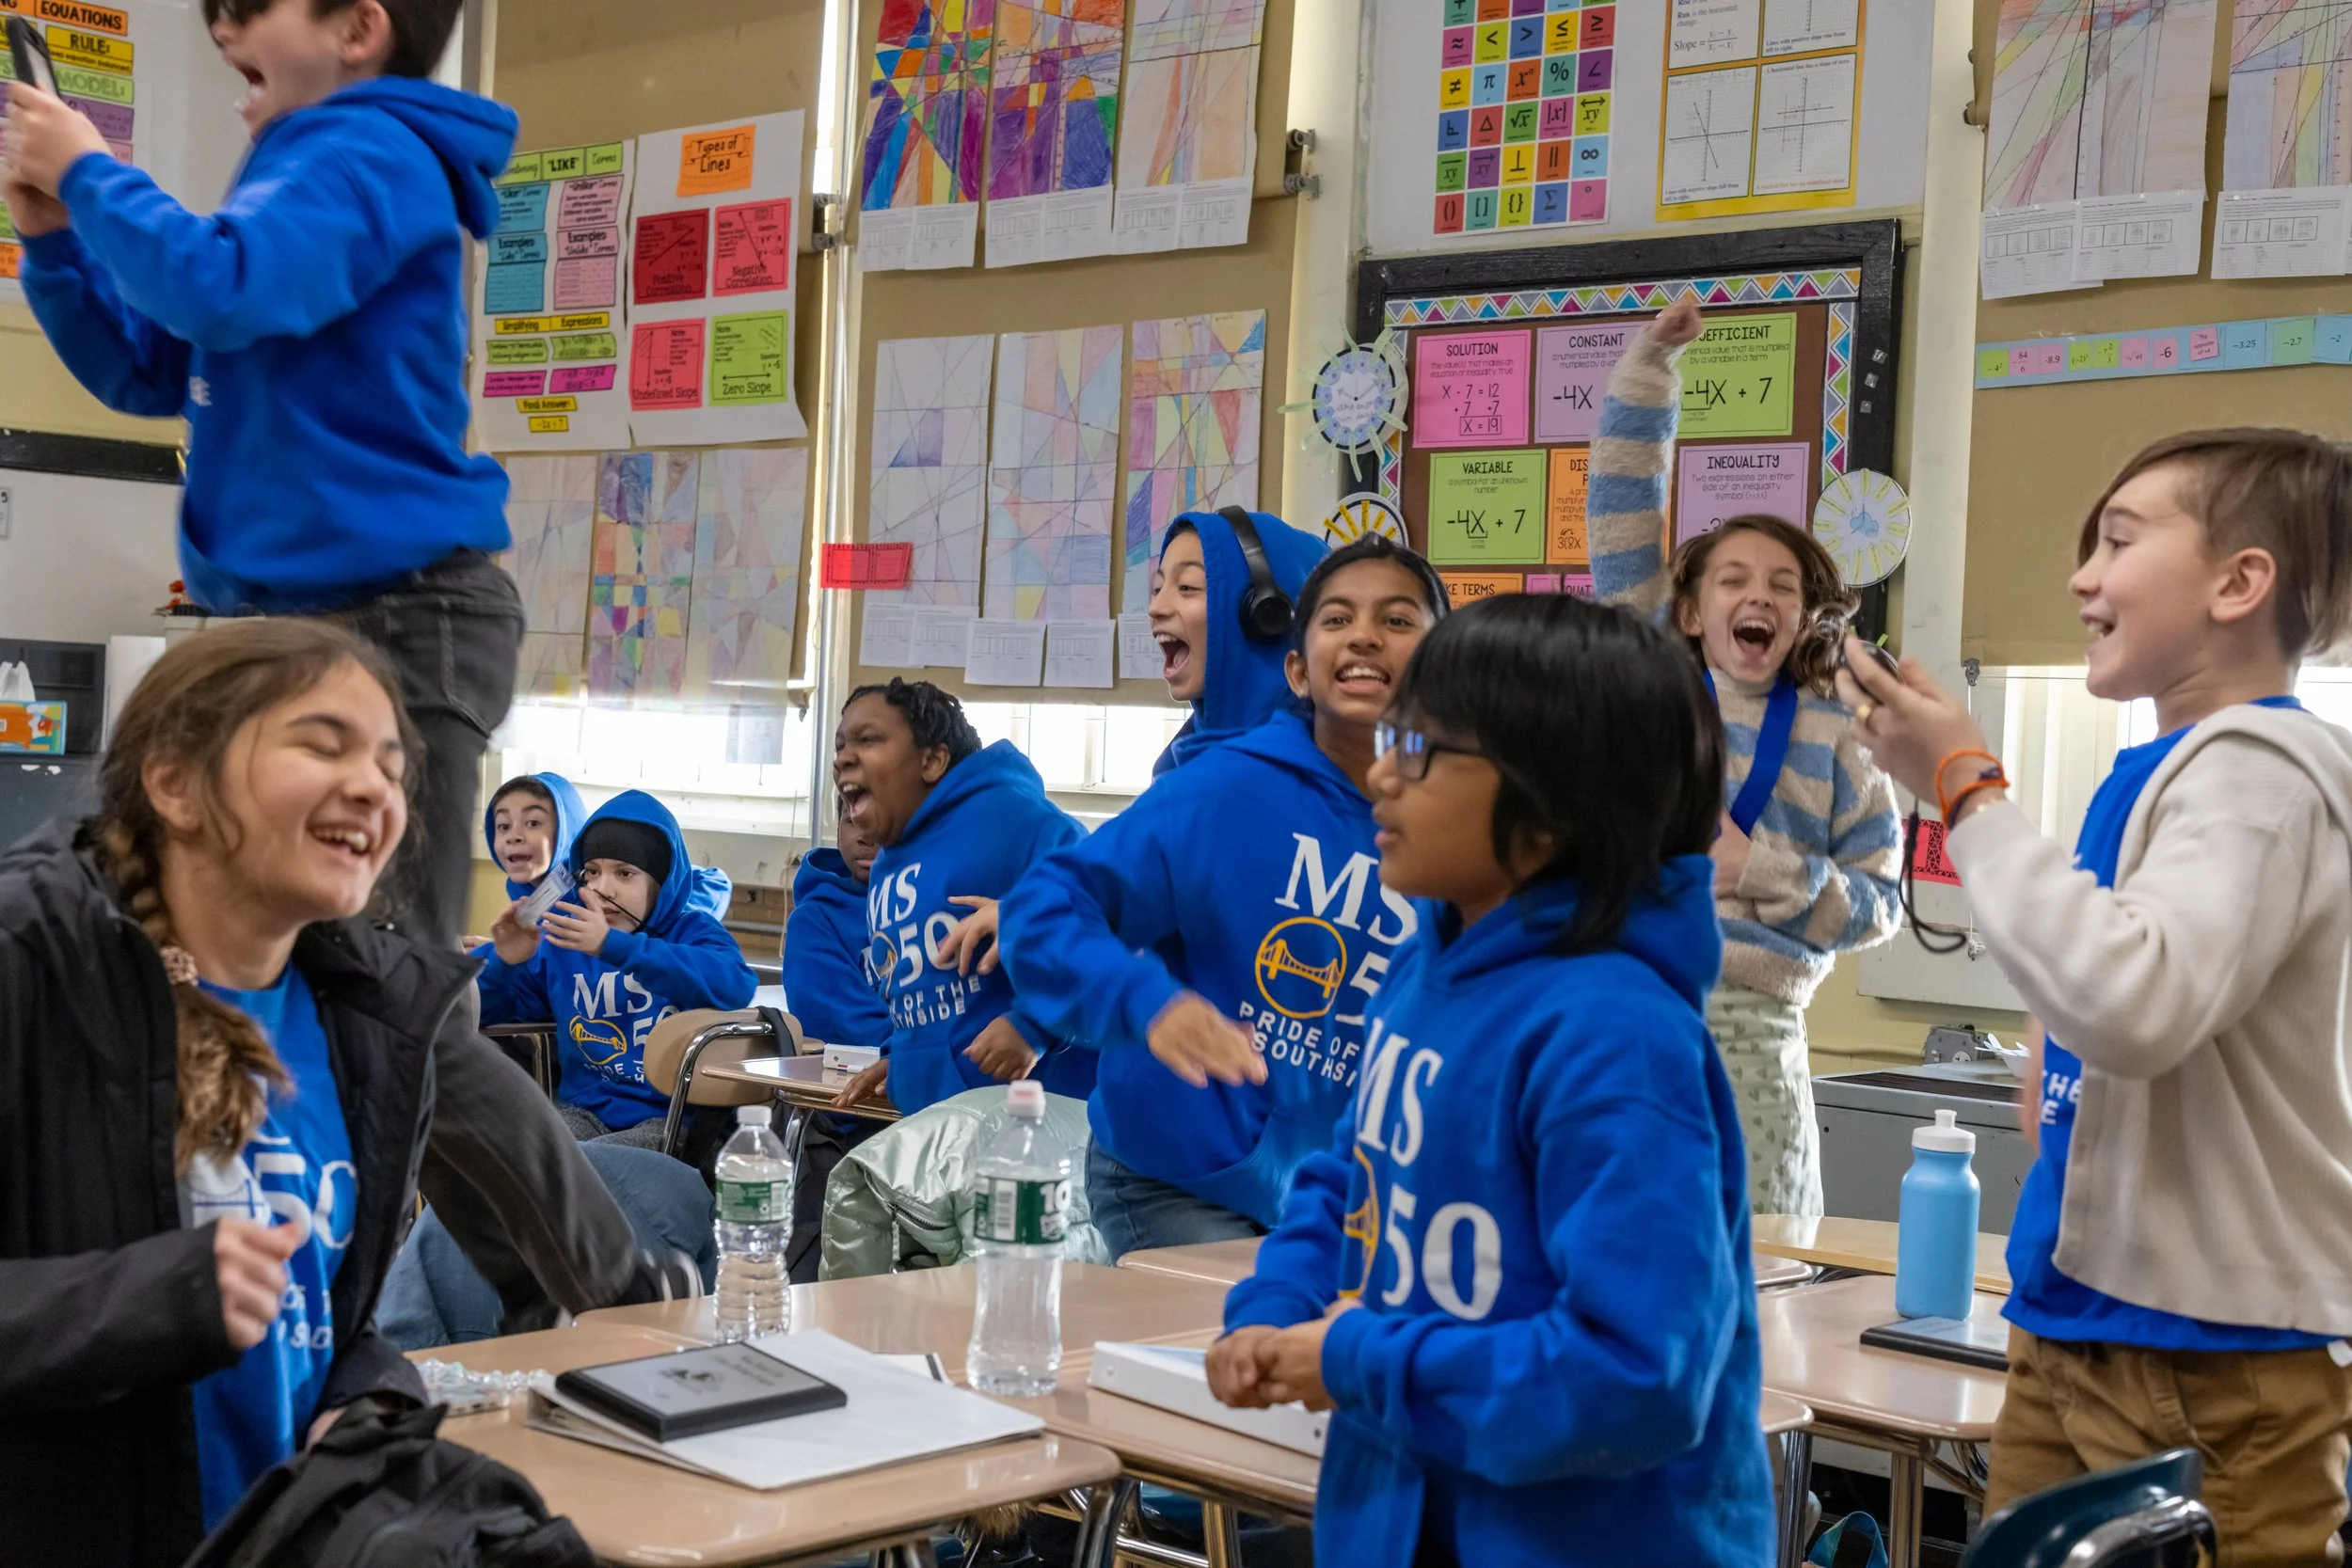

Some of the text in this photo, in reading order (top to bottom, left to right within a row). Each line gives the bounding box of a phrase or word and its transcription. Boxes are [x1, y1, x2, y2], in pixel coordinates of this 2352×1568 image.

[40, 1, 122, 30] EQUATIONS
[71, 34, 111, 54] RULE:
[1674, 40, 1697, 51] Slope
[697, 135, 738, 153] Types of
[592, 152, 616, 166] Terms
[700, 158, 731, 173] Lines
[732, 264, 767, 277] Negative
[725, 275, 773, 288] Correlation
[502, 316, 602, 332] Simplifying Expressions
[1568, 333, 1625, 348] CONSTANT
[1692, 325, 1771, 342] OEFFICIENT
[1446, 342, 1499, 356] SOLUTION
[1756, 343, 1789, 352] multiplied
[2233, 340, 2256, 349] -3.25
[2282, 338, 2302, 346] -2.7
[1557, 352, 1589, 360] numerical
[2045, 355, 2060, 364] -8.9
[2160, 346, 2171, 358] -6
[632, 388, 698, 400] Undefined Slope
[723, 383, 771, 395] Zero Slope
[1466, 384, 1473, 399] 7
[1488, 383, 1500, 398] 12
[1739, 388, 1746, 398] +
[1759, 377, 1772, 404] 7
[1464, 401, 1471, 415] 7
[1487, 418, 1499, 432] 19
[1462, 461, 1513, 474] VARIABLE
[1707, 454, 1780, 469] INEQUALITY
[1454, 478, 1477, 486] symbol
[1708, 474, 1755, 483] expressions
[1769, 472, 1794, 481] either
[1742, 483, 1782, 491] inequality
[1715, 492, 1743, 500] symbol
[1496, 519, 1502, 528] +
[1514, 509, 1526, 533] 7
[1446, 583, 1495, 595] KE TERMS
[1274, 832, 1419, 945] MS
[866, 863, 921, 943] MS
[898, 911, 960, 988] 50
[573, 971, 654, 1019] MS
[903, 974, 981, 1011] OF THE
[1335, 951, 1391, 1026] 5
[890, 997, 966, 1028] THSIDE
[1239, 1000, 1360, 1061] PRIDE OF
[1252, 1032, 1358, 1086] SOUTHSI
[1356, 1017, 1444, 1167] MS
[1382, 1182, 1503, 1322] 50
